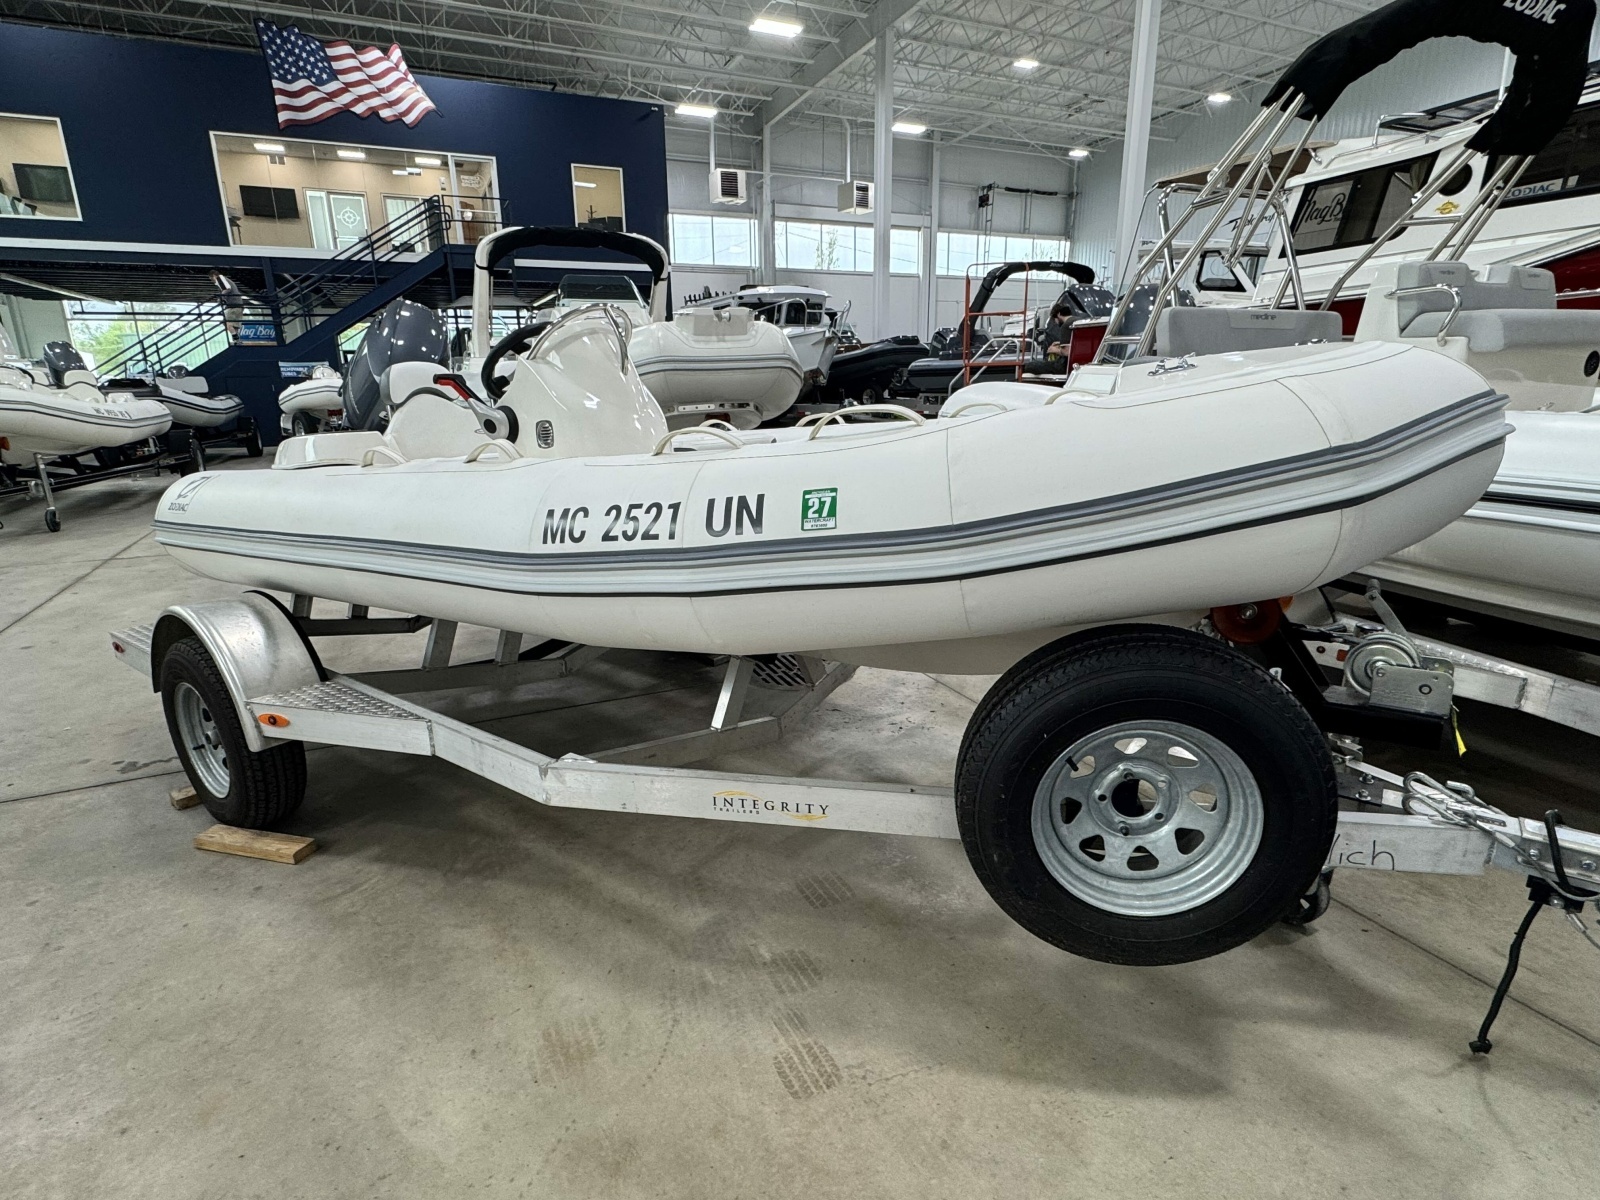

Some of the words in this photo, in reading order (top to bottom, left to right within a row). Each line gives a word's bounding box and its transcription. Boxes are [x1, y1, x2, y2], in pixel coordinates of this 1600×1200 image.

[256, 324, 276, 339] Bay
[167, 502, 190, 512] ZODIAC
[807, 496, 832, 518] 27
[542, 506, 589, 544] MC
[601, 501, 682, 542] 2521
[705, 493, 765, 538] UN
[712, 796, 829, 814] INTEGRITY
